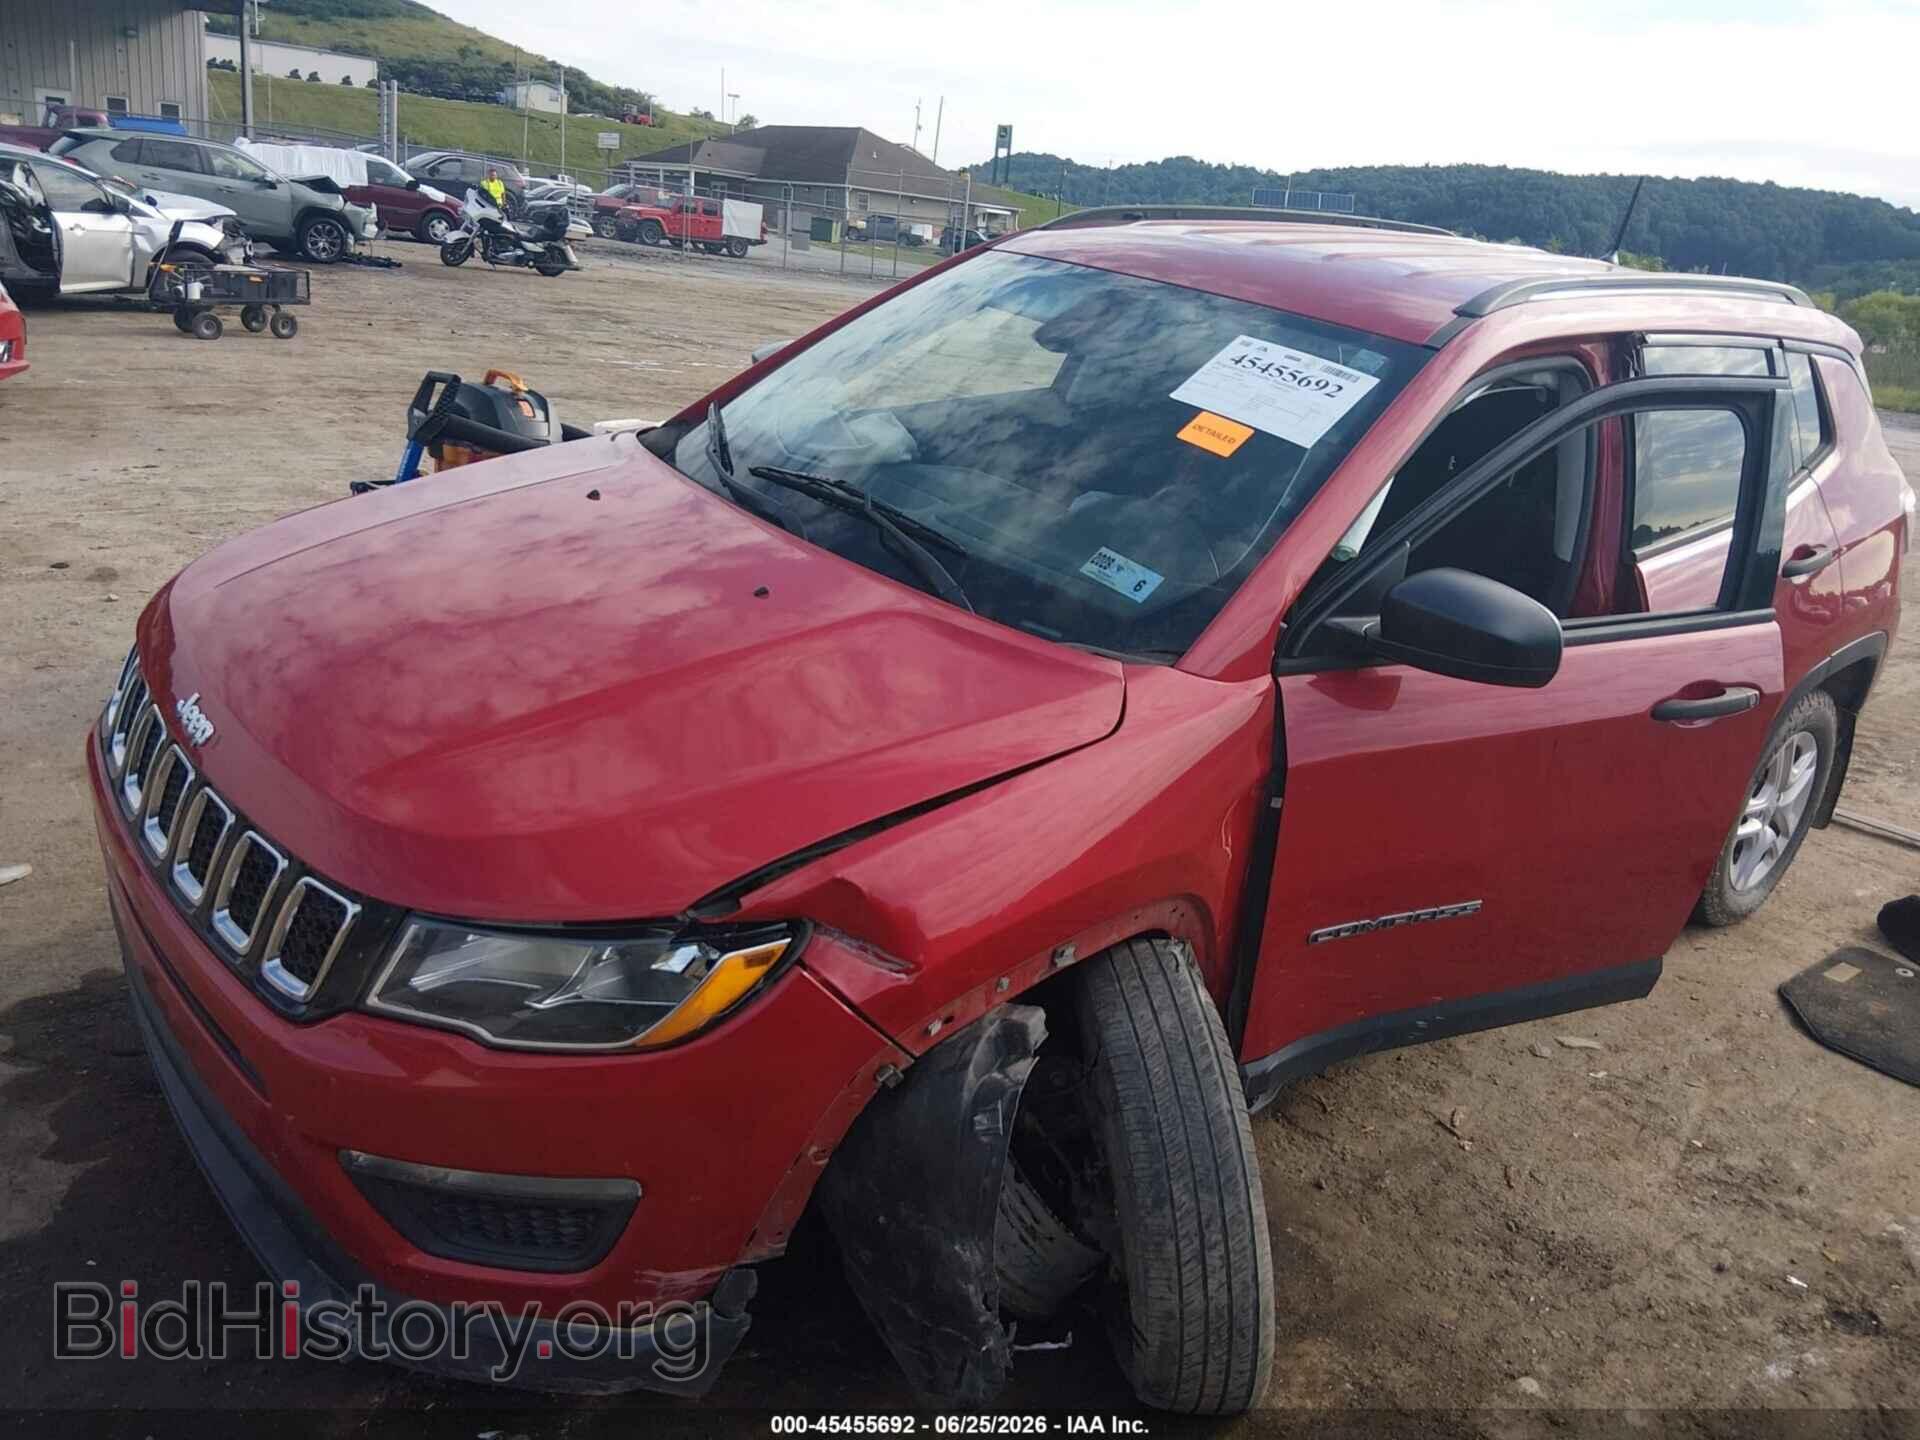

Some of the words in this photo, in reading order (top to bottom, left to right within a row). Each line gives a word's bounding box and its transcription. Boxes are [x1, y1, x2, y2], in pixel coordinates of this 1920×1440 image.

[1230, 353, 1344, 398] 45455692
[1192, 423, 1237, 445] DETAILED
[1133, 579, 1147, 592] 6
[176, 692, 215, 745] Jeep
[1307, 899, 1483, 944] COMPASS
